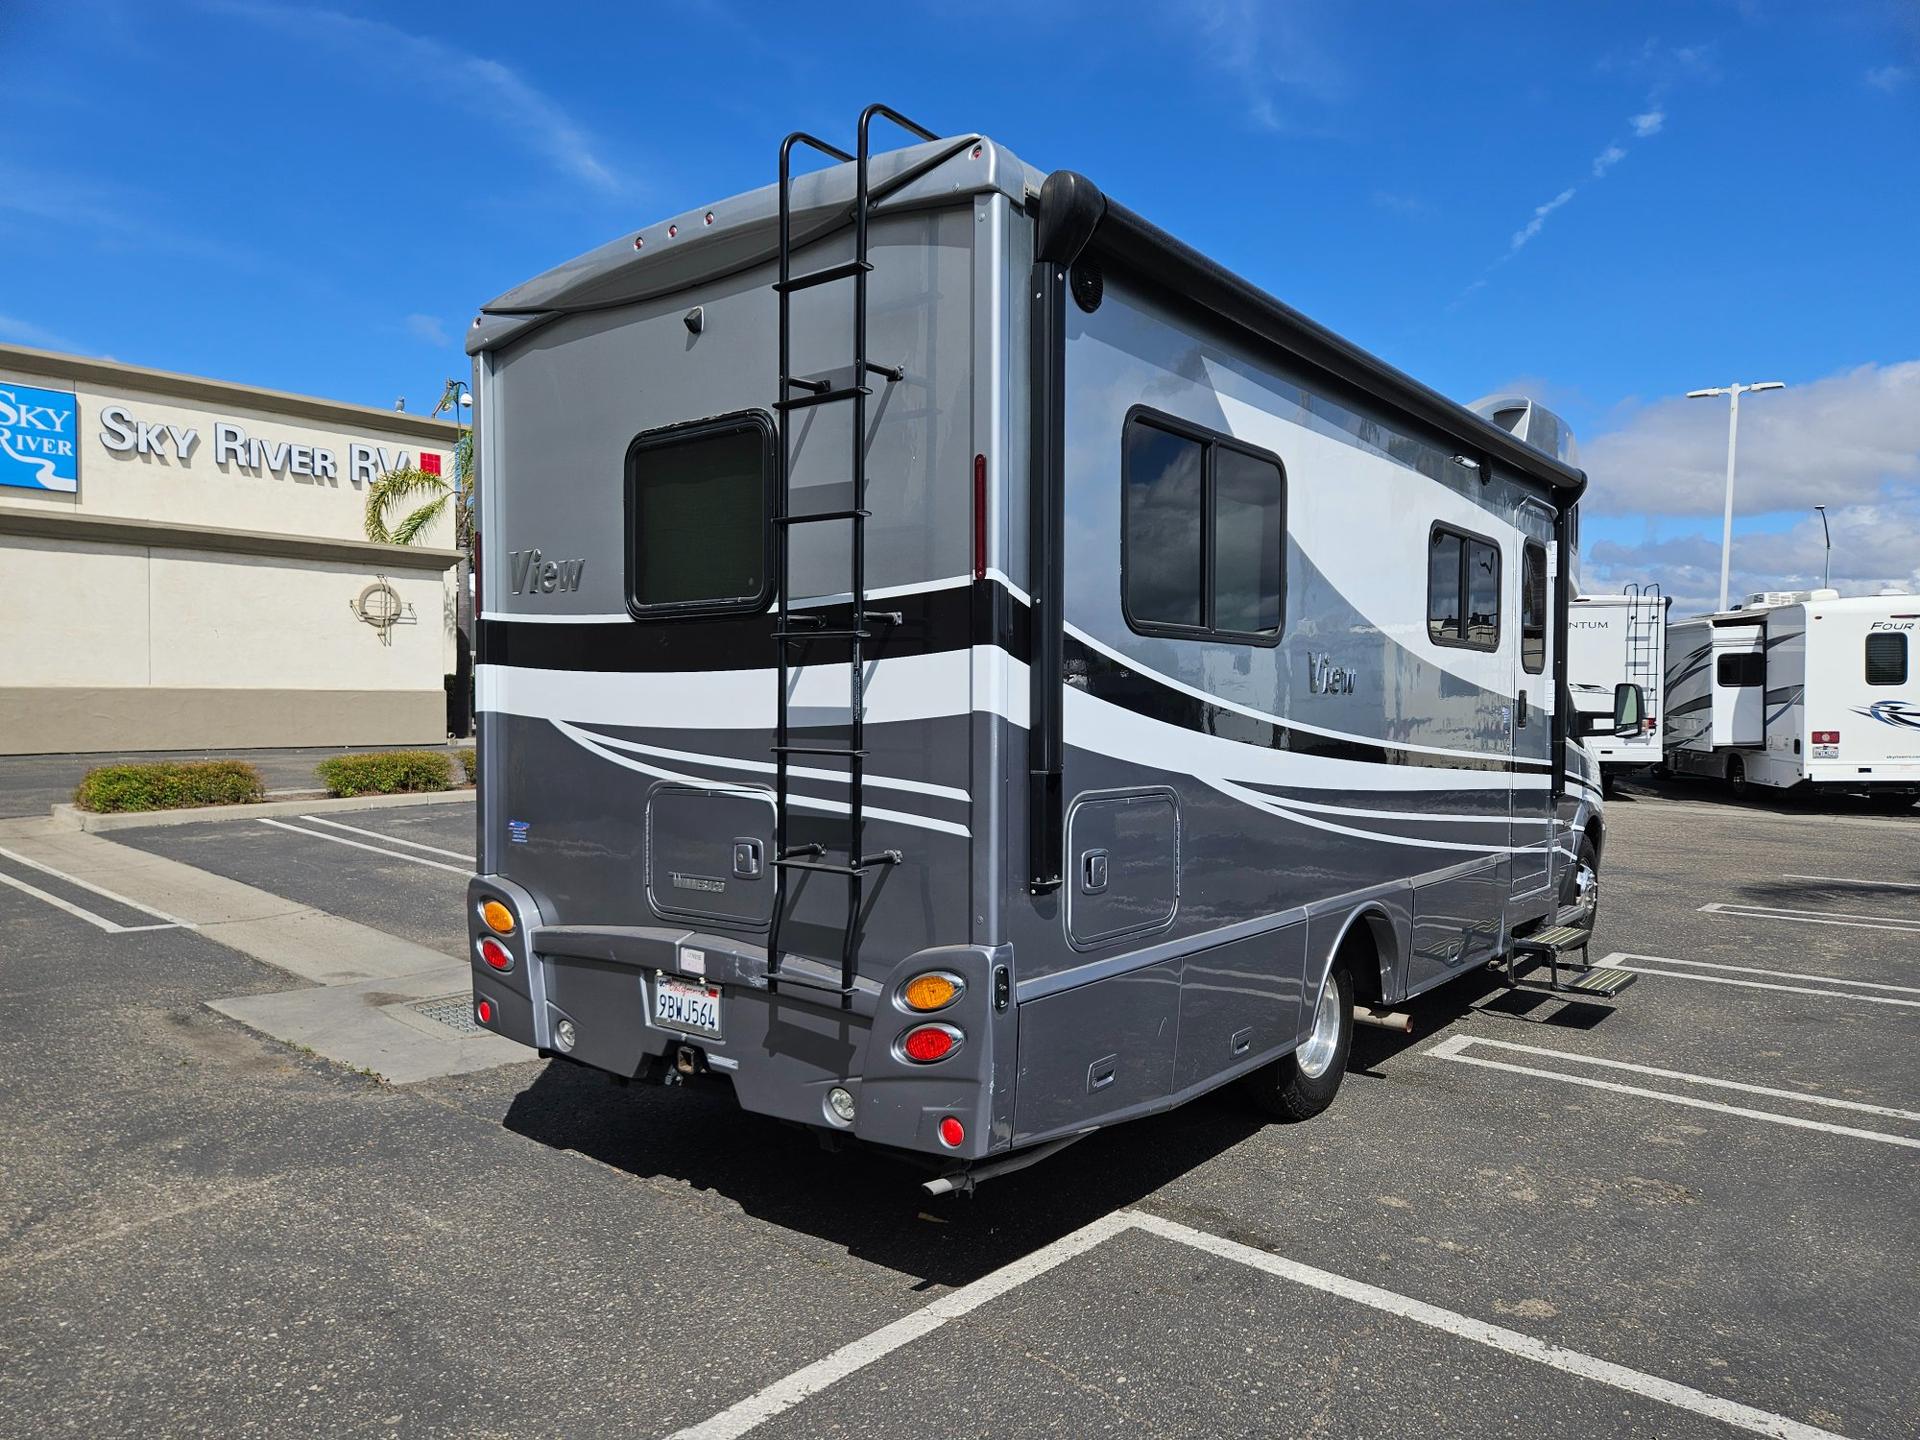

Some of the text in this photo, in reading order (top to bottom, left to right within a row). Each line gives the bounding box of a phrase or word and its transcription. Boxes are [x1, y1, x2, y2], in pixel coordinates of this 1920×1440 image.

[0, 390, 71, 432] SKY
[99, 406, 409, 483] SKY RIVER RV
[508, 548, 585, 595] View
[1568, 621, 1608, 629] NTUM
[1870, 621, 1915, 630] FOUR
[1307, 651, 1356, 695] View
[659, 994, 715, 1028] 9BWJ564
